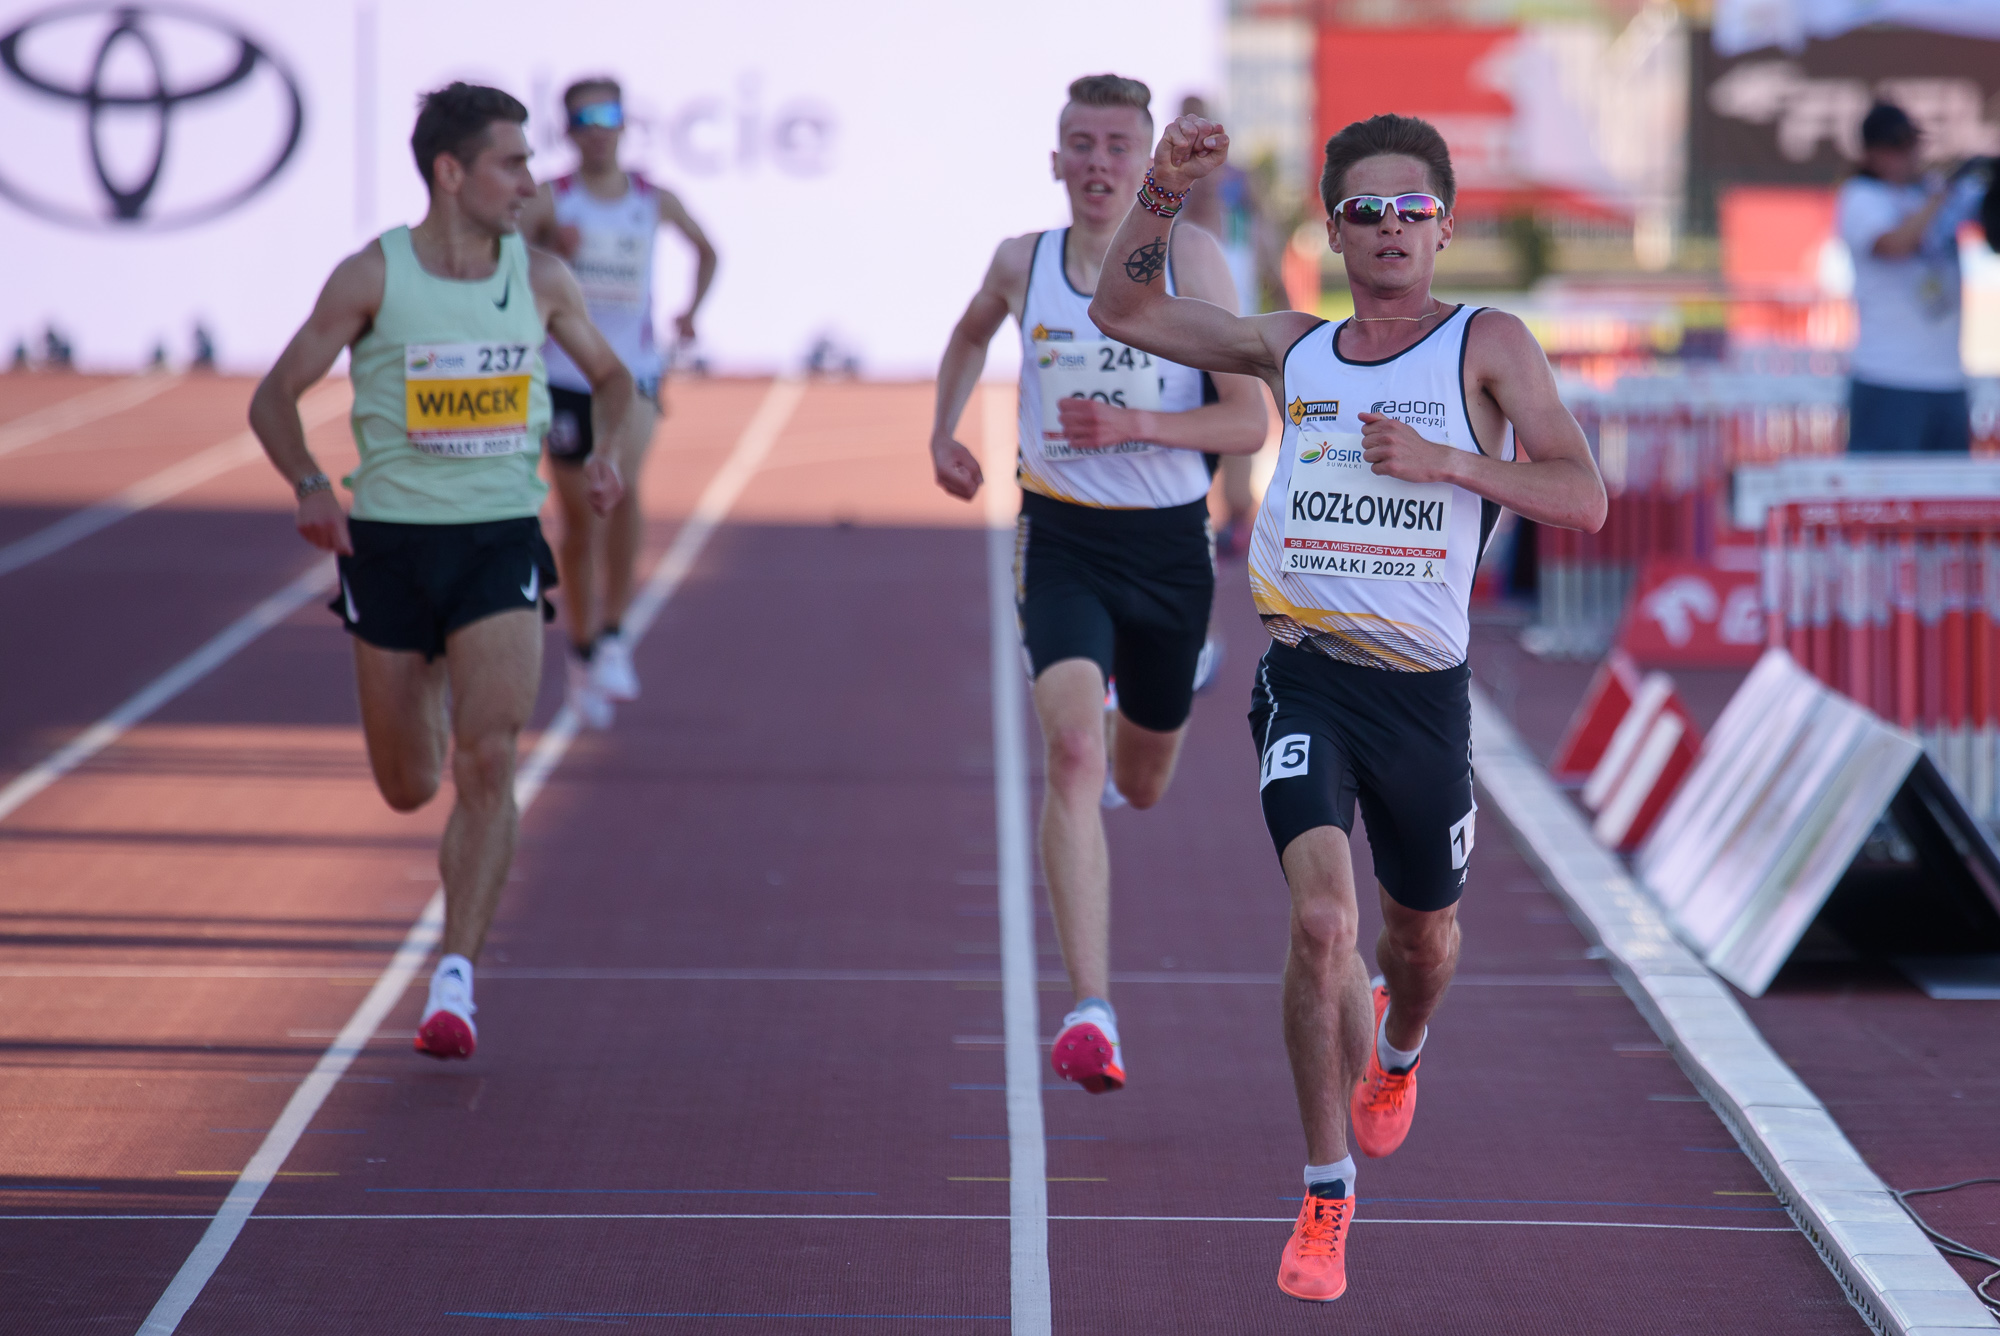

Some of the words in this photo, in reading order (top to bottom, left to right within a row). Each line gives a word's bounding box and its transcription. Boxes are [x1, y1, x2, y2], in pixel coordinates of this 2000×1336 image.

[479, 346, 528, 373] 237
[416, 387, 520, 421] WIĄCEK
[1306, 402, 1337, 414] OPTIMA
[1404, 415, 1446, 428] precyzji
[1326, 448, 1362, 463] OSIR
[1326, 461, 1362, 469] SUWAŁKI
[1291, 490, 1444, 532] KOZŁOWSKI
[1290, 539, 1304, 548] 98.
[1305, 540, 1329, 550] PZLA
[1331, 543, 1405, 556] MISTRZOSTWA
[1405, 549, 1442, 558] POLSKI
[1290, 553, 1366, 574] SUWAŁKI
[1371, 560, 1416, 577] 2022
[1262, 739, 1306, 778] 15
